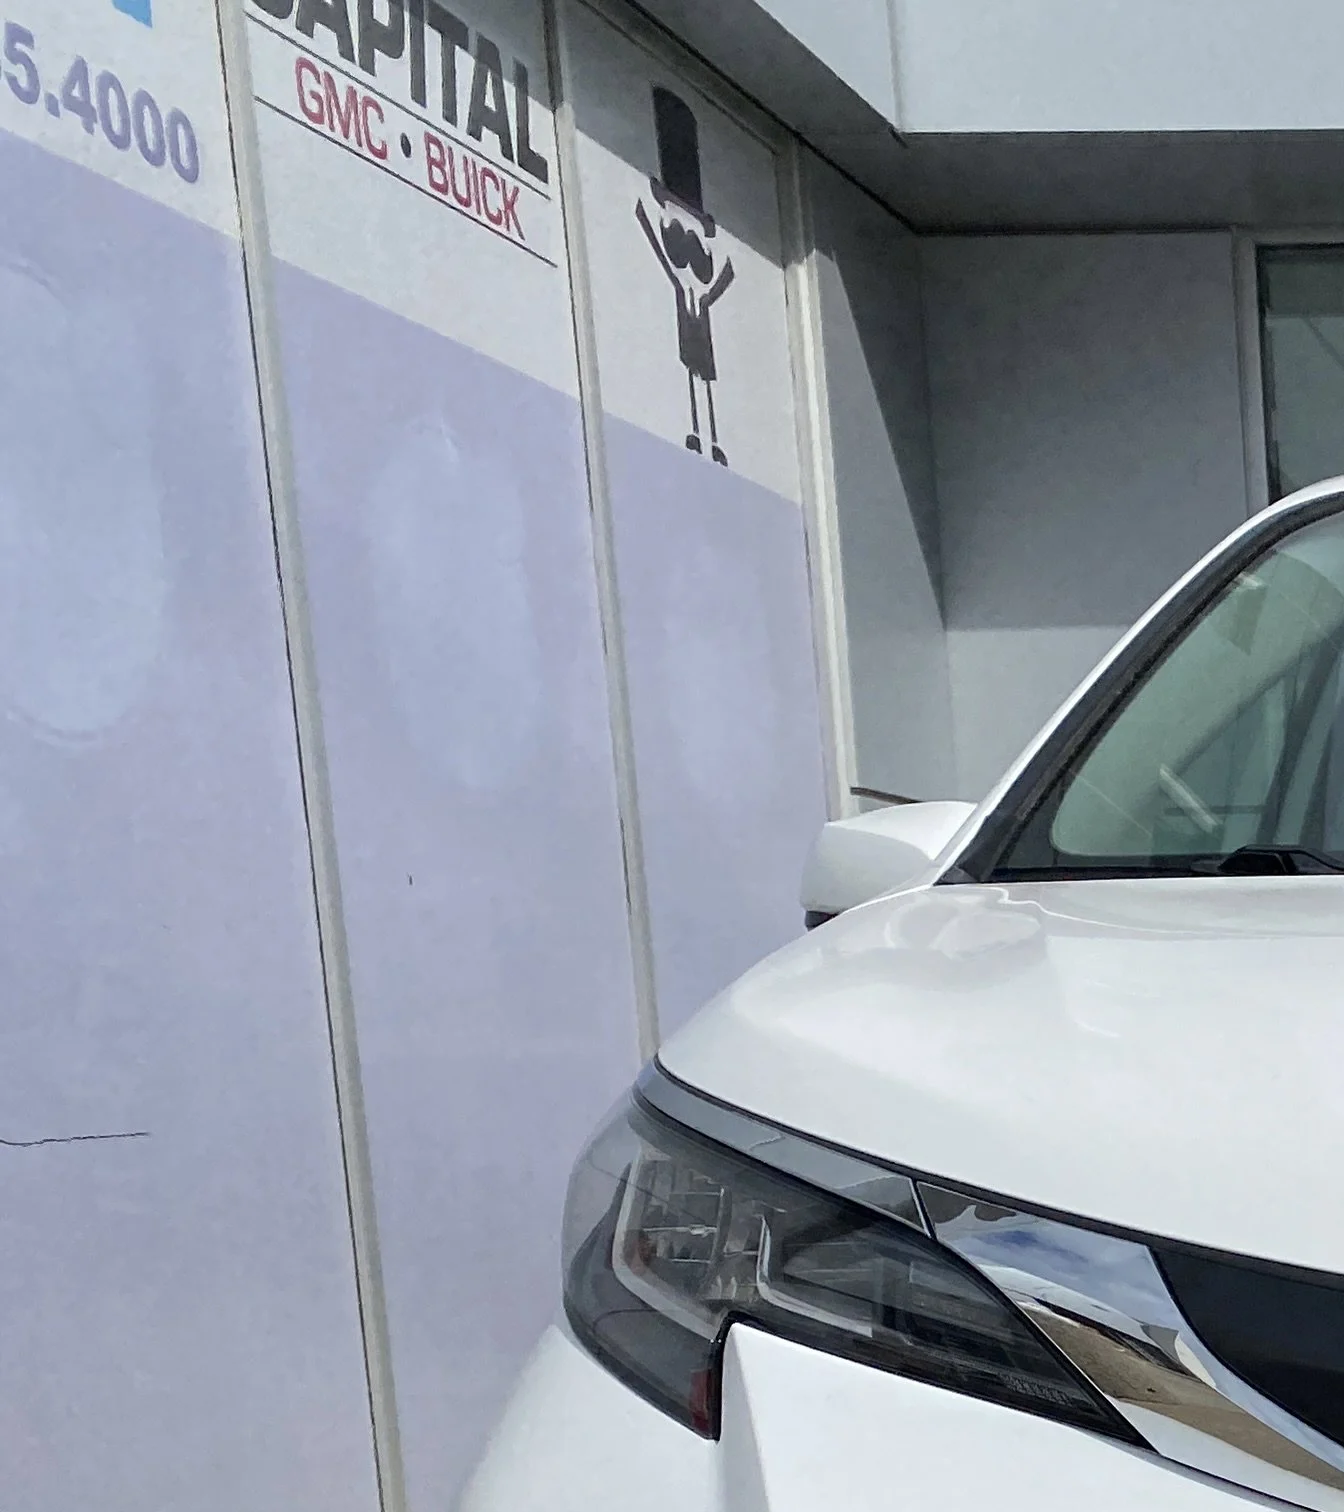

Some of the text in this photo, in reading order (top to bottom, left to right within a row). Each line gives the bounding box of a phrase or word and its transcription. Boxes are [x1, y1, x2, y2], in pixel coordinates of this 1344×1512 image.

[0, 20, 200, 184] 5.4000
[251, 0, 549, 184] APITAL
[295, 56, 526, 241] GMC BUICK
